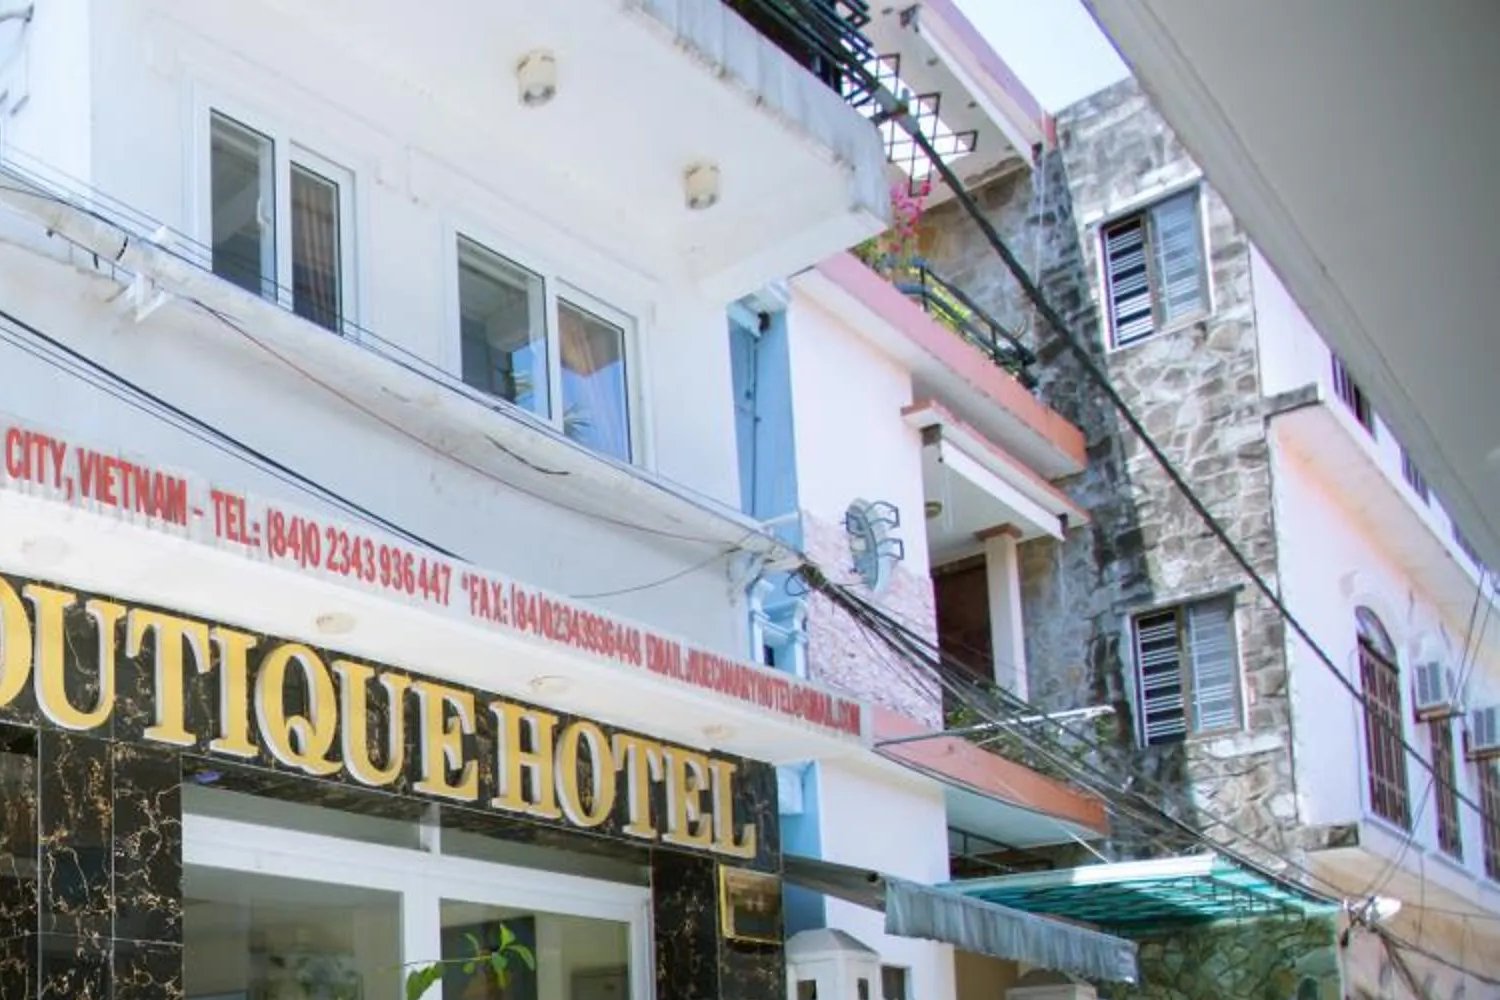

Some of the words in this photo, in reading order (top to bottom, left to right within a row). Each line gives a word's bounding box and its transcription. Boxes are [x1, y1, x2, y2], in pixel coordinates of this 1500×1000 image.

[5, 427, 75, 501] CITY,
[77, 446, 188, 526] VIETNAM
[211, 489, 261, 547] TEL:
[266, 507, 322, 570] (84)0
[325, 526, 377, 584] 2343
[379, 544, 415, 596] 936
[418, 558, 452, 606] 447
[490, 700, 758, 861] HOTEL
